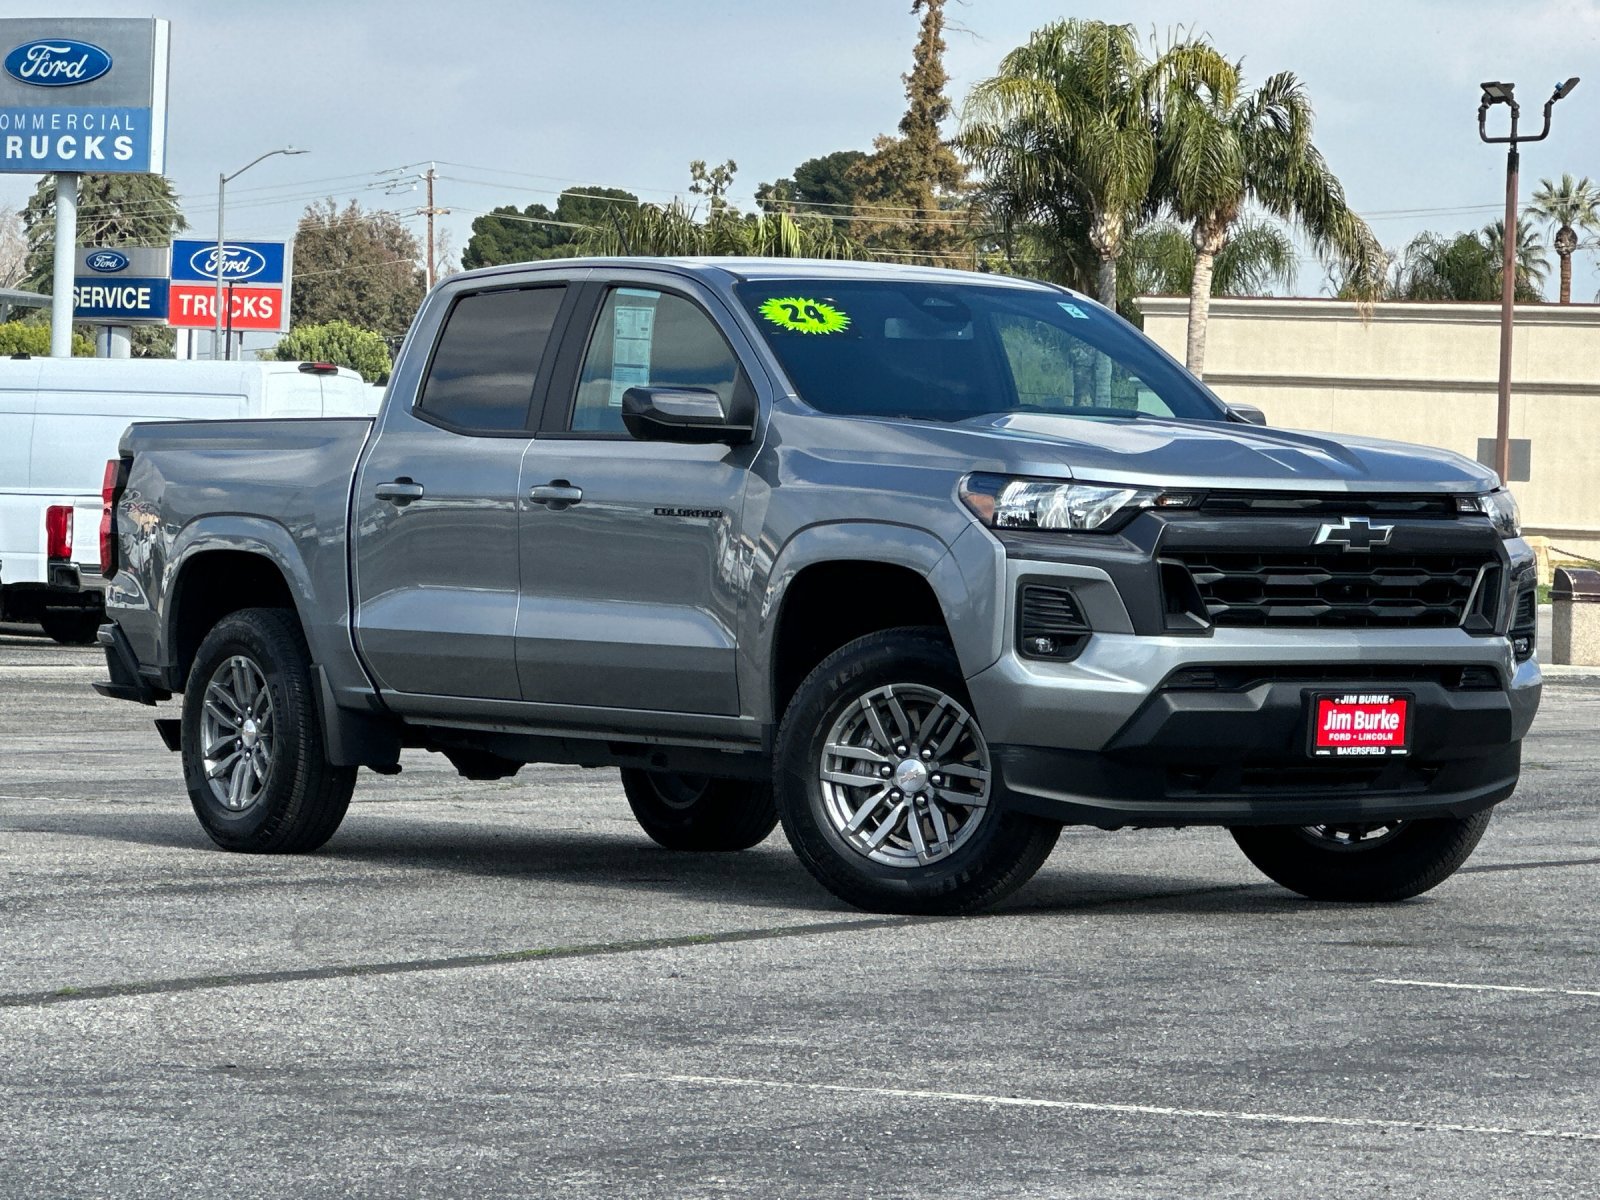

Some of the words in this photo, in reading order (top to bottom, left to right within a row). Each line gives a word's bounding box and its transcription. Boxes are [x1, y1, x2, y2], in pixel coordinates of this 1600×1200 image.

[19, 44, 89, 79] Ford
[0, 113, 135, 131] OMMERCIAL
[5, 135, 134, 161] RUCKS
[93, 255, 118, 268] Ford
[205, 249, 252, 273] Ford
[178, 294, 273, 319] TRUCKS
[1341, 695, 1357, 704] JIM
[1358, 695, 1389, 704] BURKE
[1323, 709, 1352, 730] Jim
[1353, 709, 1400, 730] Burke
[1337, 746, 1386, 755] BAKERSFIELD
